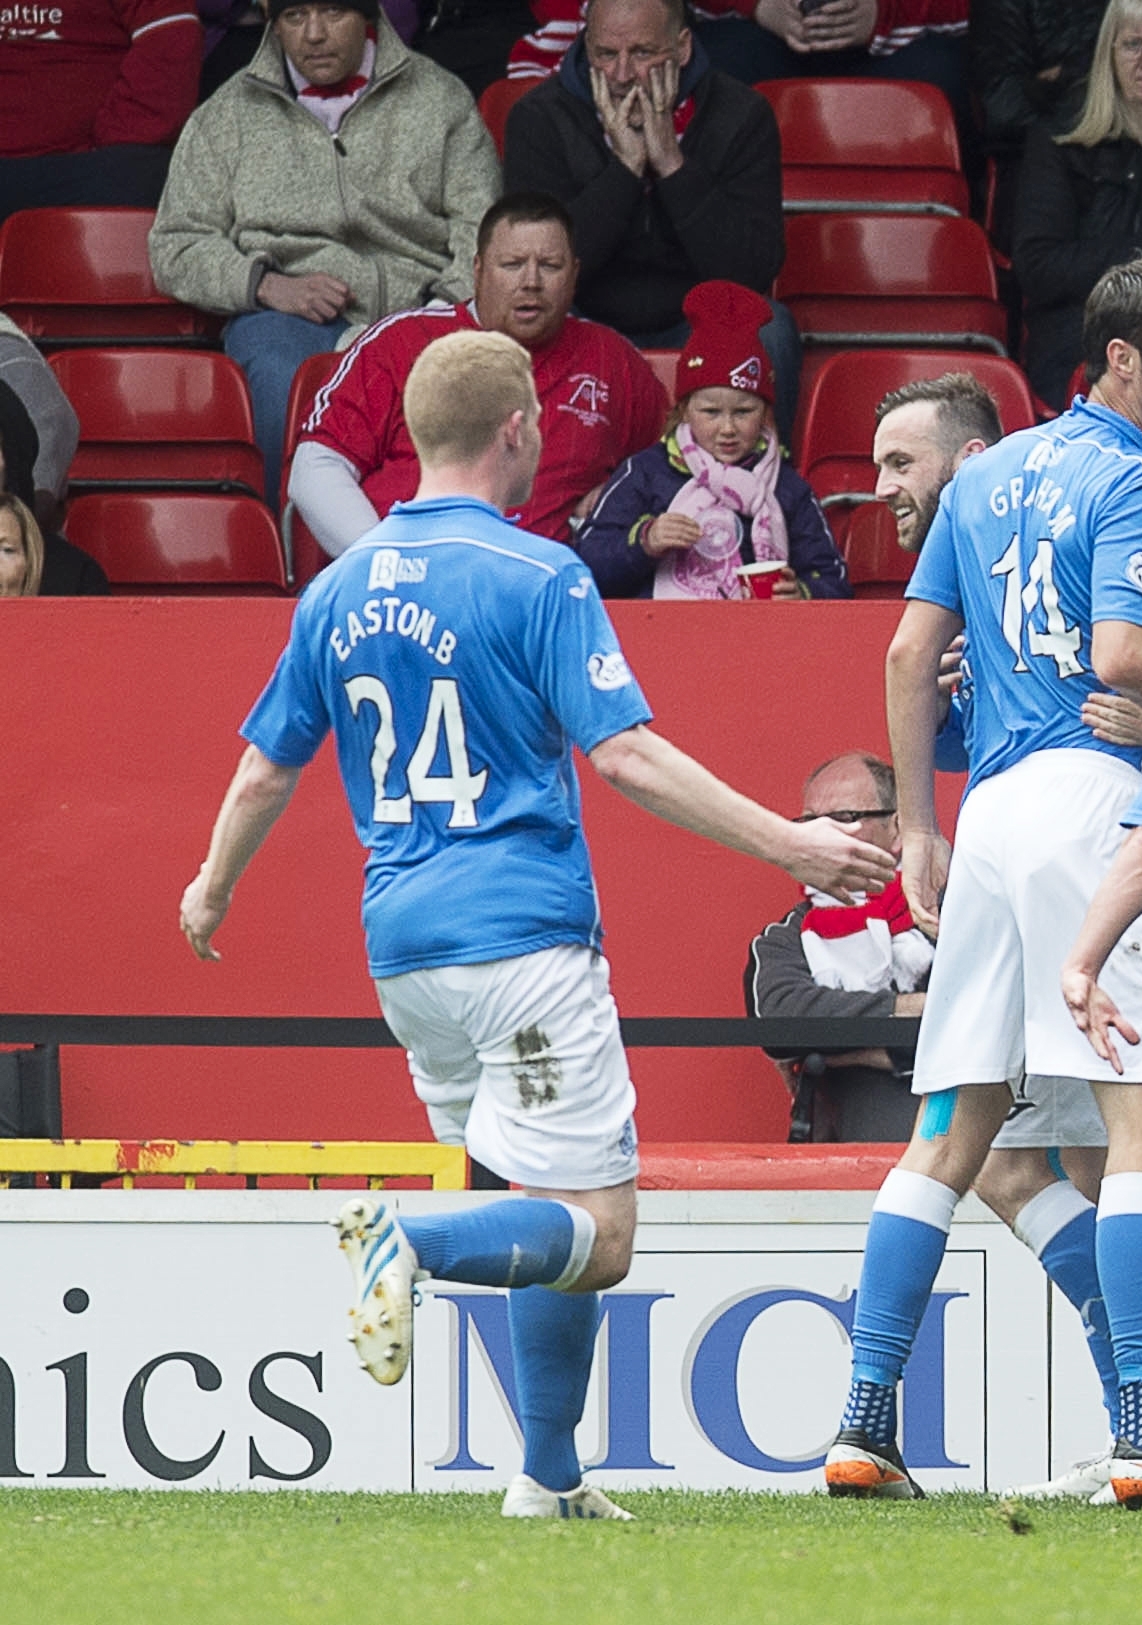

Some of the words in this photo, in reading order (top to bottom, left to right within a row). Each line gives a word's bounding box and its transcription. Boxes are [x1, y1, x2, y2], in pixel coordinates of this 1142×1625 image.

[329, 596, 457, 665] EASTON.B
[990, 532, 1083, 679] 14
[343, 674, 490, 829] 24
[428, 1286, 970, 1474] MCI
